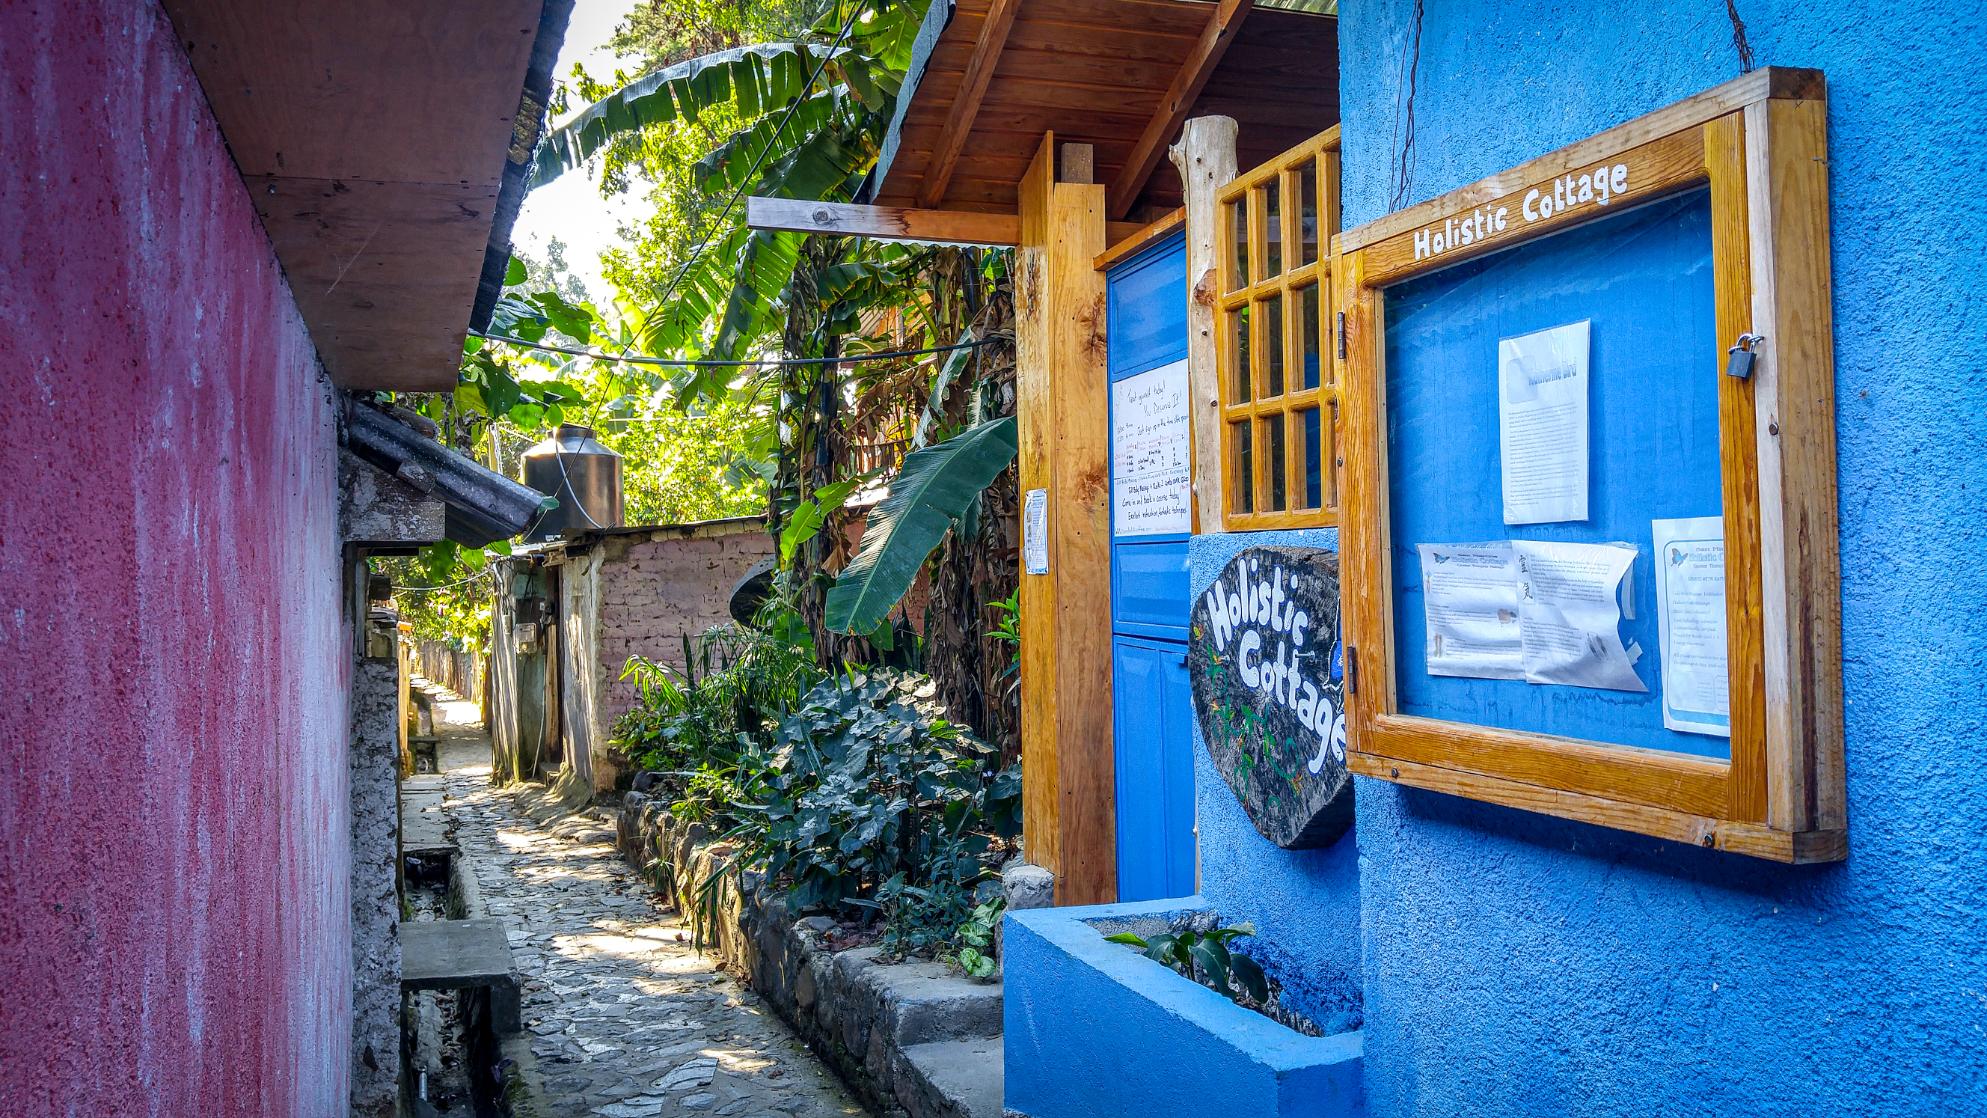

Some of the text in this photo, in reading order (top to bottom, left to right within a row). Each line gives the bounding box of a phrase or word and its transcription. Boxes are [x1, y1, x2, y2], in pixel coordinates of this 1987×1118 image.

[1414, 163, 1628, 260] Holistic Cottage
[1206, 558, 1308, 653] Holistic
